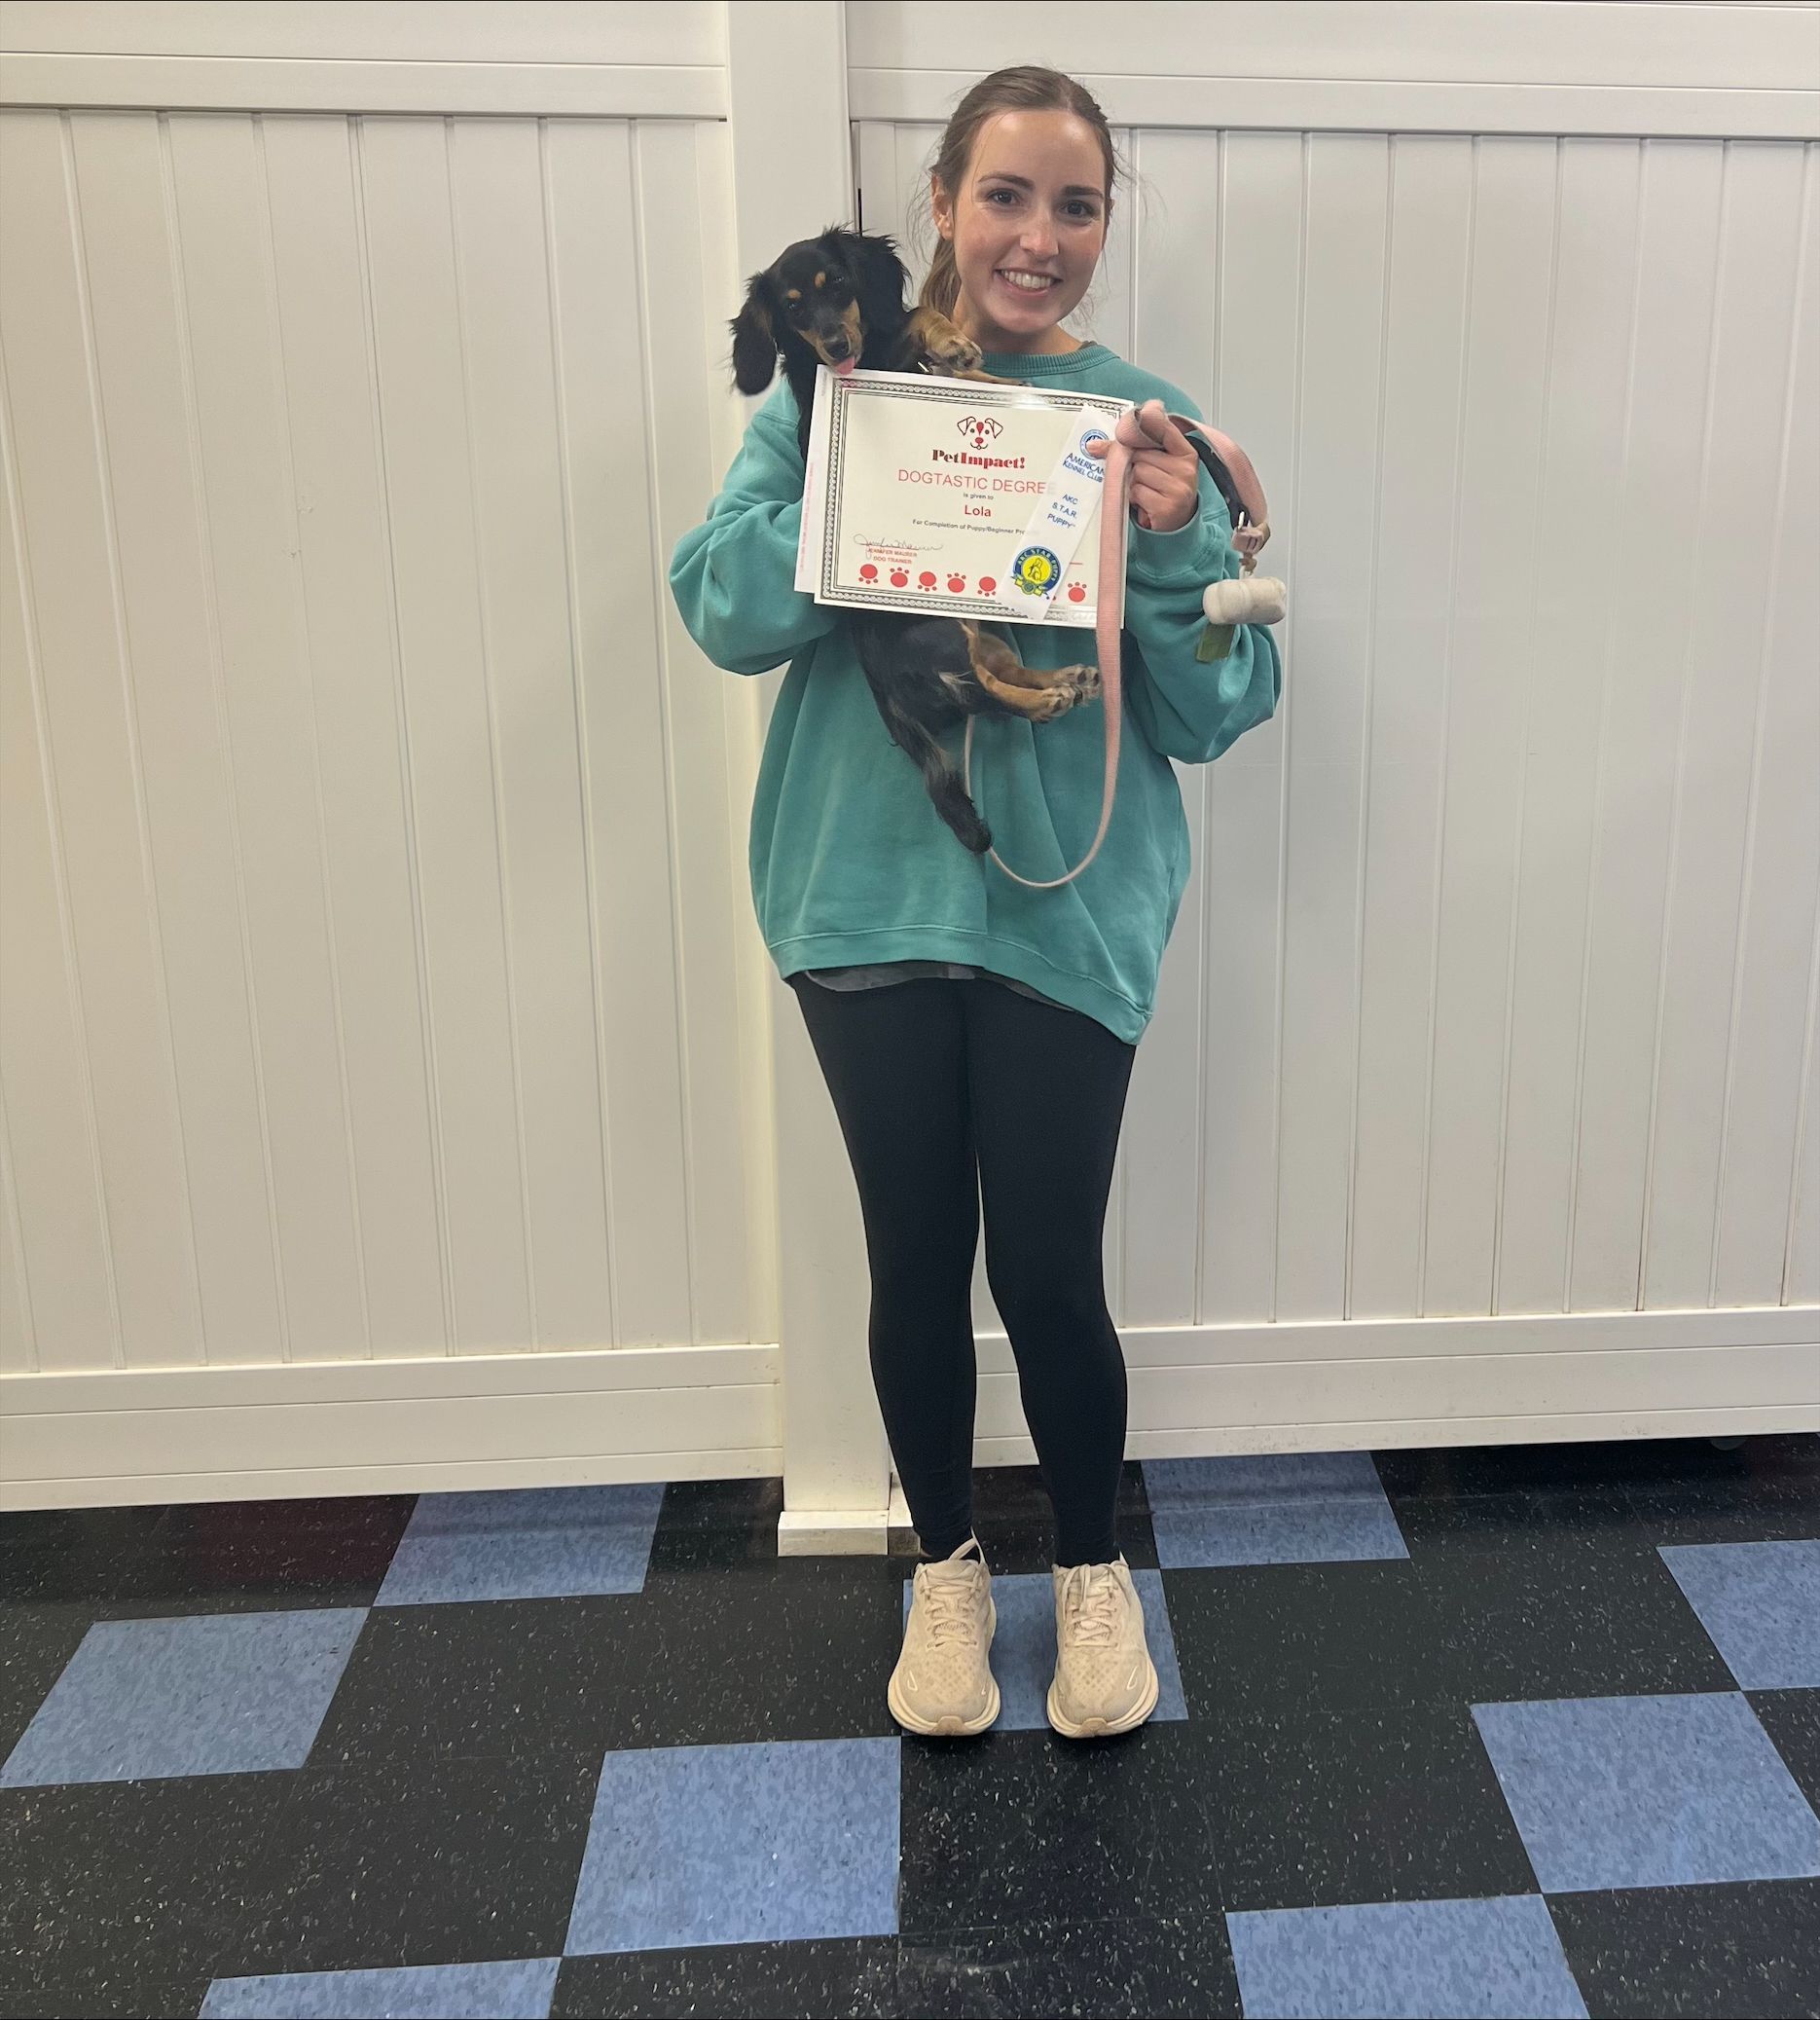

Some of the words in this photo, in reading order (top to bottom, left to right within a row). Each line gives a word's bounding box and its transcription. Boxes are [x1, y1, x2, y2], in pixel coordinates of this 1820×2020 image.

[932, 449, 1025, 469] PetImpact!
[898, 469, 988, 490] DOGTASTIC
[1063, 460, 1085, 476] KENNEL
[1086, 471, 1104, 483] CLUB
[1062, 494, 1078, 505] AKC
[965, 504, 992, 517] Lola
[924, 520, 959, 530] Completion
